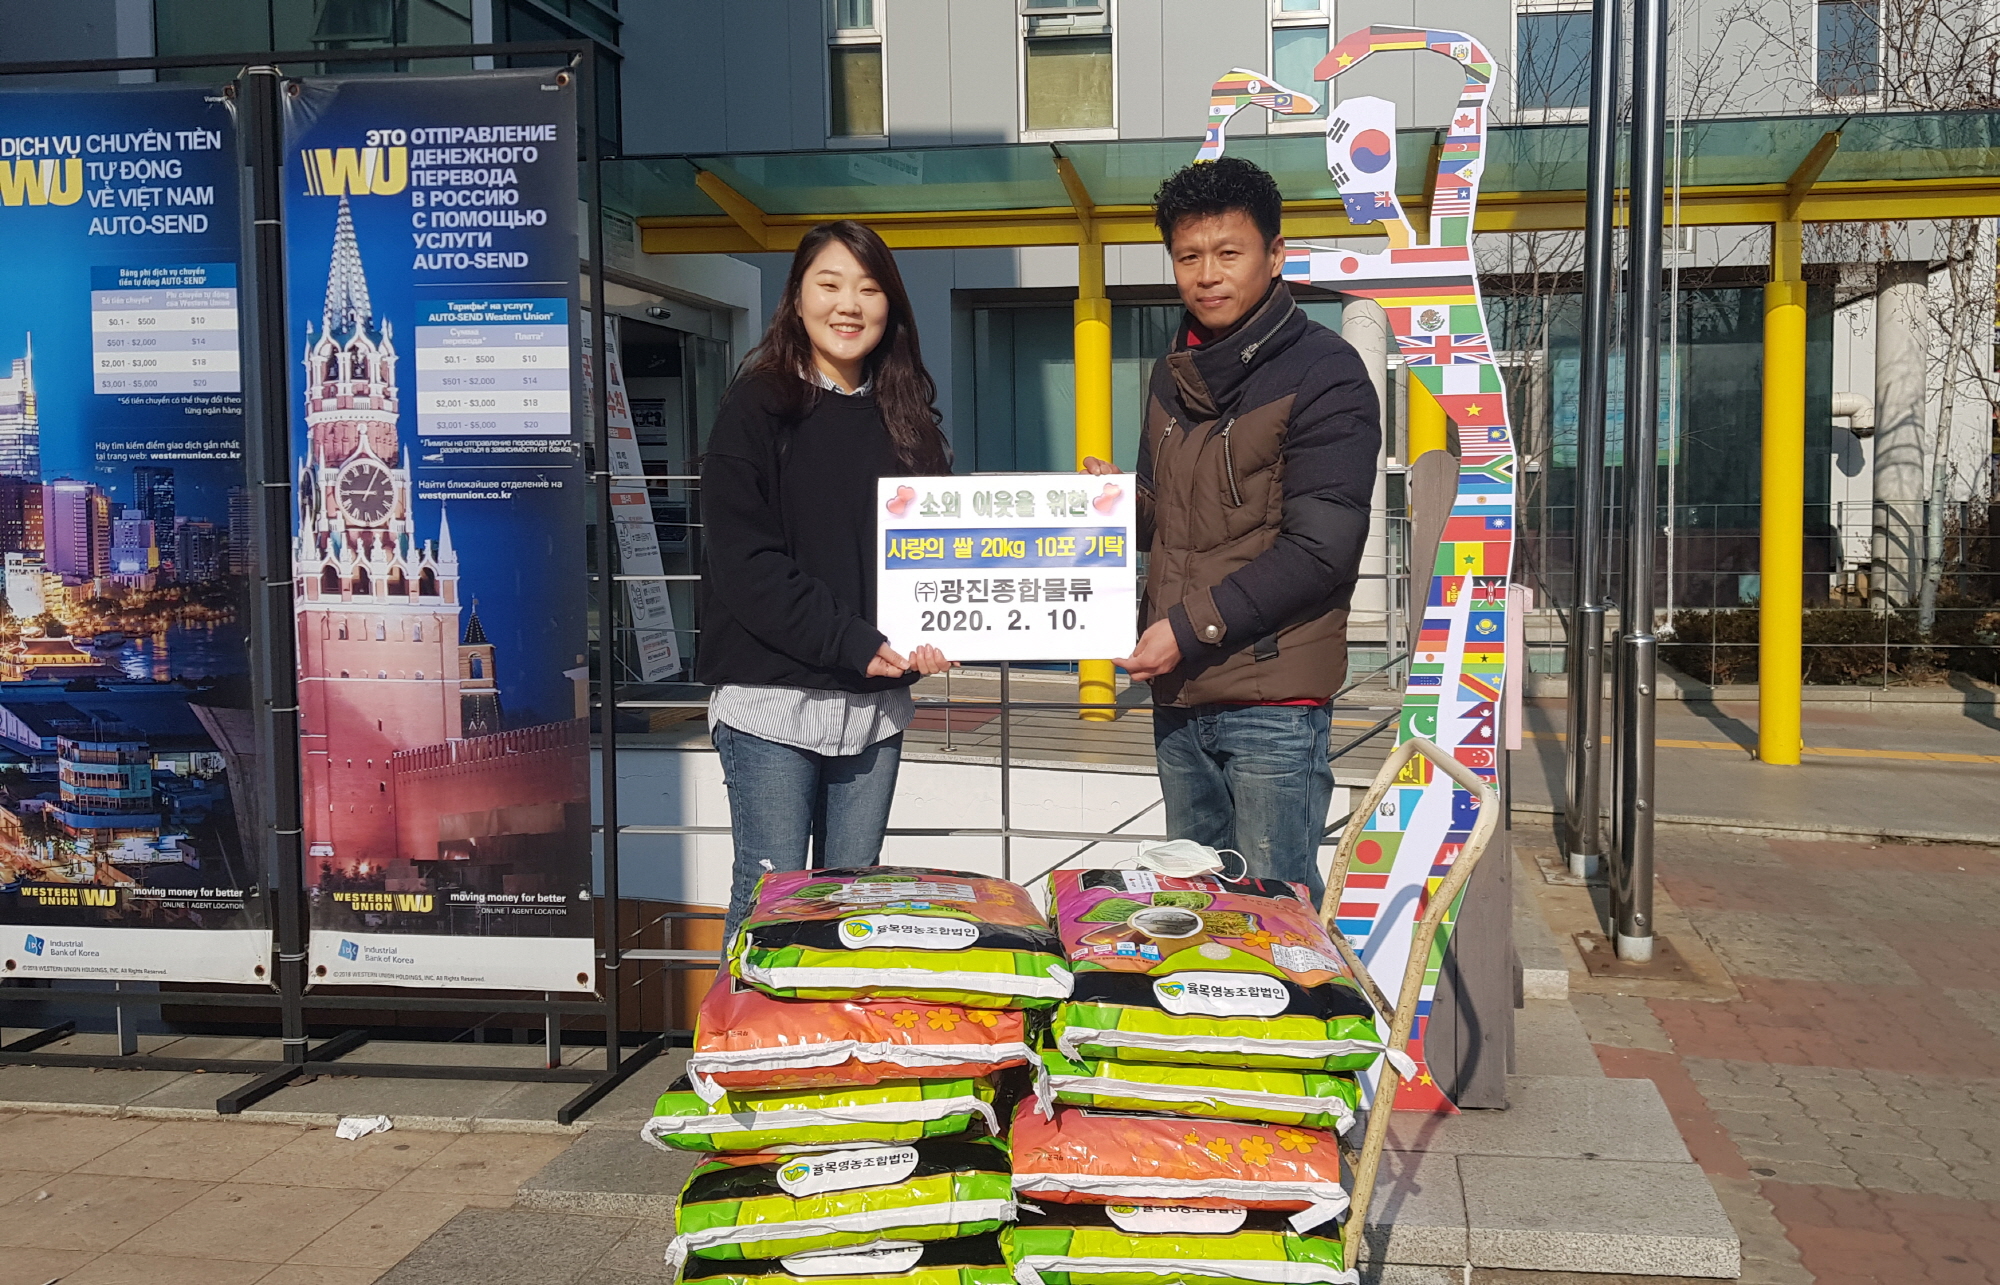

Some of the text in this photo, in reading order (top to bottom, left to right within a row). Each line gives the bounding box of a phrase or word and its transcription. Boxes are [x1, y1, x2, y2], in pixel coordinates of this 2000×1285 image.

[86, 127, 221, 152] CHUYỂN TIỀN
[365, 129, 406, 147] ЭТО
[410, 125, 557, 145] ОТПРАВЛЕНИЕ
[1, 135, 81, 160] DỊCH VỤ
[410, 146, 538, 168] ДЕНЕЖНОГО
[86, 159, 182, 185] TỰ ĐỘNG
[315, 147, 408, 195] WU
[0, 158, 83, 206] WU
[411, 168, 518, 187] ПЕРЕВОДА
[87, 185, 214, 211] VỀ VIỆT NAM
[411, 189, 519, 207] В РОССИЮ
[412, 209, 547, 230] С ПОМОЩЬЮ
[88, 214, 208, 236] AUTO-SEND
[412, 232, 492, 249] УСЛУГИ
[413, 252, 528, 270] AUTO-SEND
[490, 303, 501, 311] на
[503, 302, 534, 311] услугу
[109, 317, 156, 326] $0.1 $500
[191, 317, 205, 325] $10
[428, 313, 483, 322] AUTO-SEND
[485, 313, 522, 321] Western
[107, 338, 156, 347] $501 $2,000
[191, 337, 206, 345] $14
[101, 359, 157, 368] $2,001 $3,000
[192, 358, 206, 366] $18
[444, 355, 495, 364] $0.1 $500
[522, 354, 537, 363] $10
[102, 379, 157, 389] $3,001 $5,000
[193, 379, 207, 387] $20
[442, 377, 495, 386] $501 $2,000
[523, 376, 537, 385] $14
[436, 399, 496, 408] $2,001 $3,000
[523, 398, 538, 407] $18
[436, 420, 496, 430] $3,001 $5,000
[523, 420, 539, 429] $20
[167, 441, 183, 451] giao
[107, 453, 127, 461] trang
[150, 451, 241, 459] westernunion.co.kr
[418, 480, 446, 489] Найти
[447, 480, 499, 489] ближайшее
[501, 480, 549, 490] отделение
[418, 490, 512, 500] westernunion.co.kr
[919, 488, 1089, 518] 소외 이웃을 위한
[887, 535, 1125, 560] 사랑의 쌀 20kg 10포 기탁
[921, 608, 1086, 631] 2020. 2. 10.
[21, 887, 78, 898] WESTERN
[133, 887, 243, 899] moving money for better
[333, 892, 392, 902] WESTERN
[39, 896, 78, 906] UNION
[83, 889, 117, 907] WU
[450, 892, 566, 904] moving money for better
[162, 901, 185, 909] ONLINE
[213, 902, 244, 910] LOCATION
[352, 902, 392, 911] UNION
[400, 894, 433, 913] WU
[481, 907, 505, 915] ONLINE
[534, 908, 567, 916] LOCATION
[50, 940, 83, 948] Industrial
[69, 948, 77, 956] of
[79, 949, 100, 957] Korea
[364, 946, 398, 955] Industrial
[365, 954, 415, 964] Bank of Korea
[1187, 982, 1284, 1000] 율목영농조합법인
[812, 1151, 914, 1176] 율목영농조합법인
